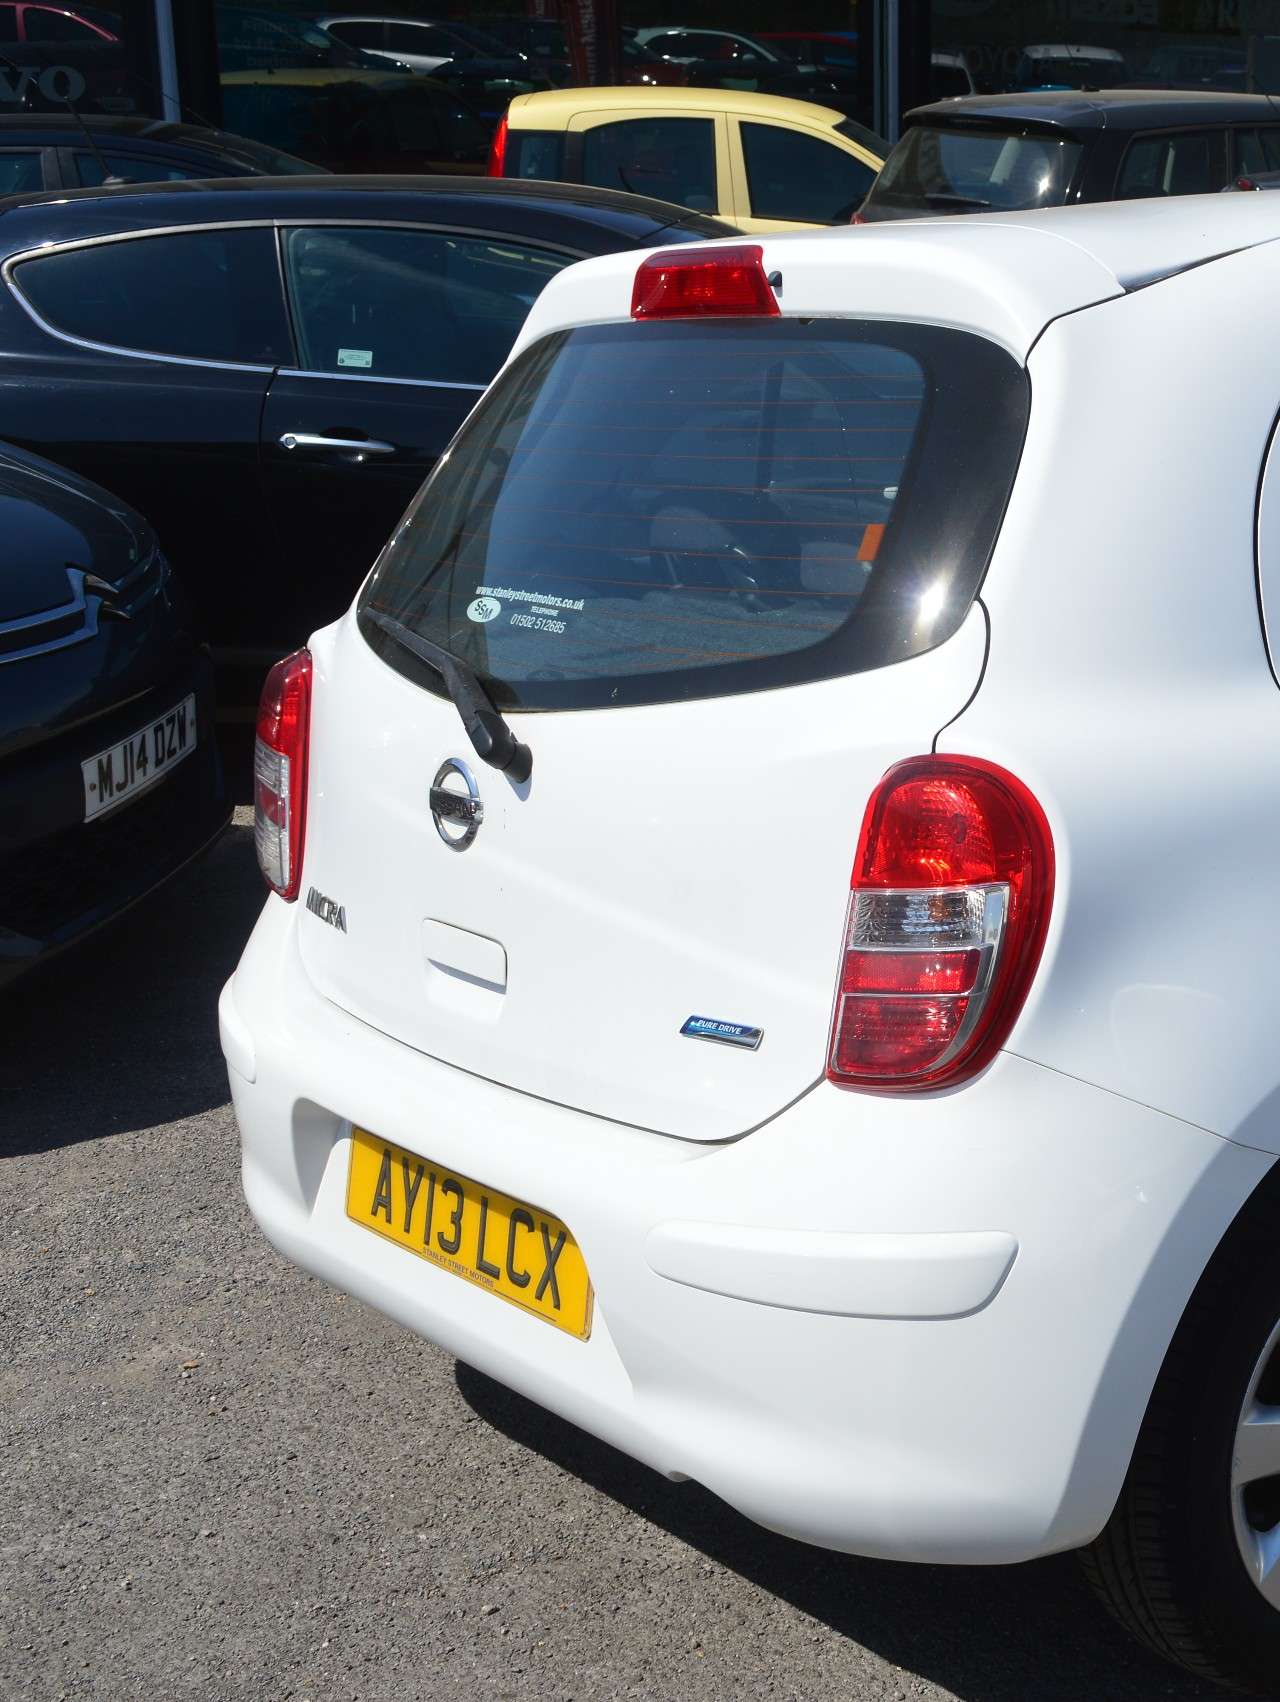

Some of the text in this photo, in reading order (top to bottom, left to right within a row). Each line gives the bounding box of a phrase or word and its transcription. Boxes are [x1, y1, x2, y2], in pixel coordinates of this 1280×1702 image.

[474, 600, 494, 620] SSM
[510, 613, 567, 634] 01502 512685
[97, 733, 149, 803] MJ14
[306, 886, 347, 934] MICRA
[697, 1019, 742, 1035] PURE DRIVE
[371, 1148, 568, 1311] AY13 LCX
